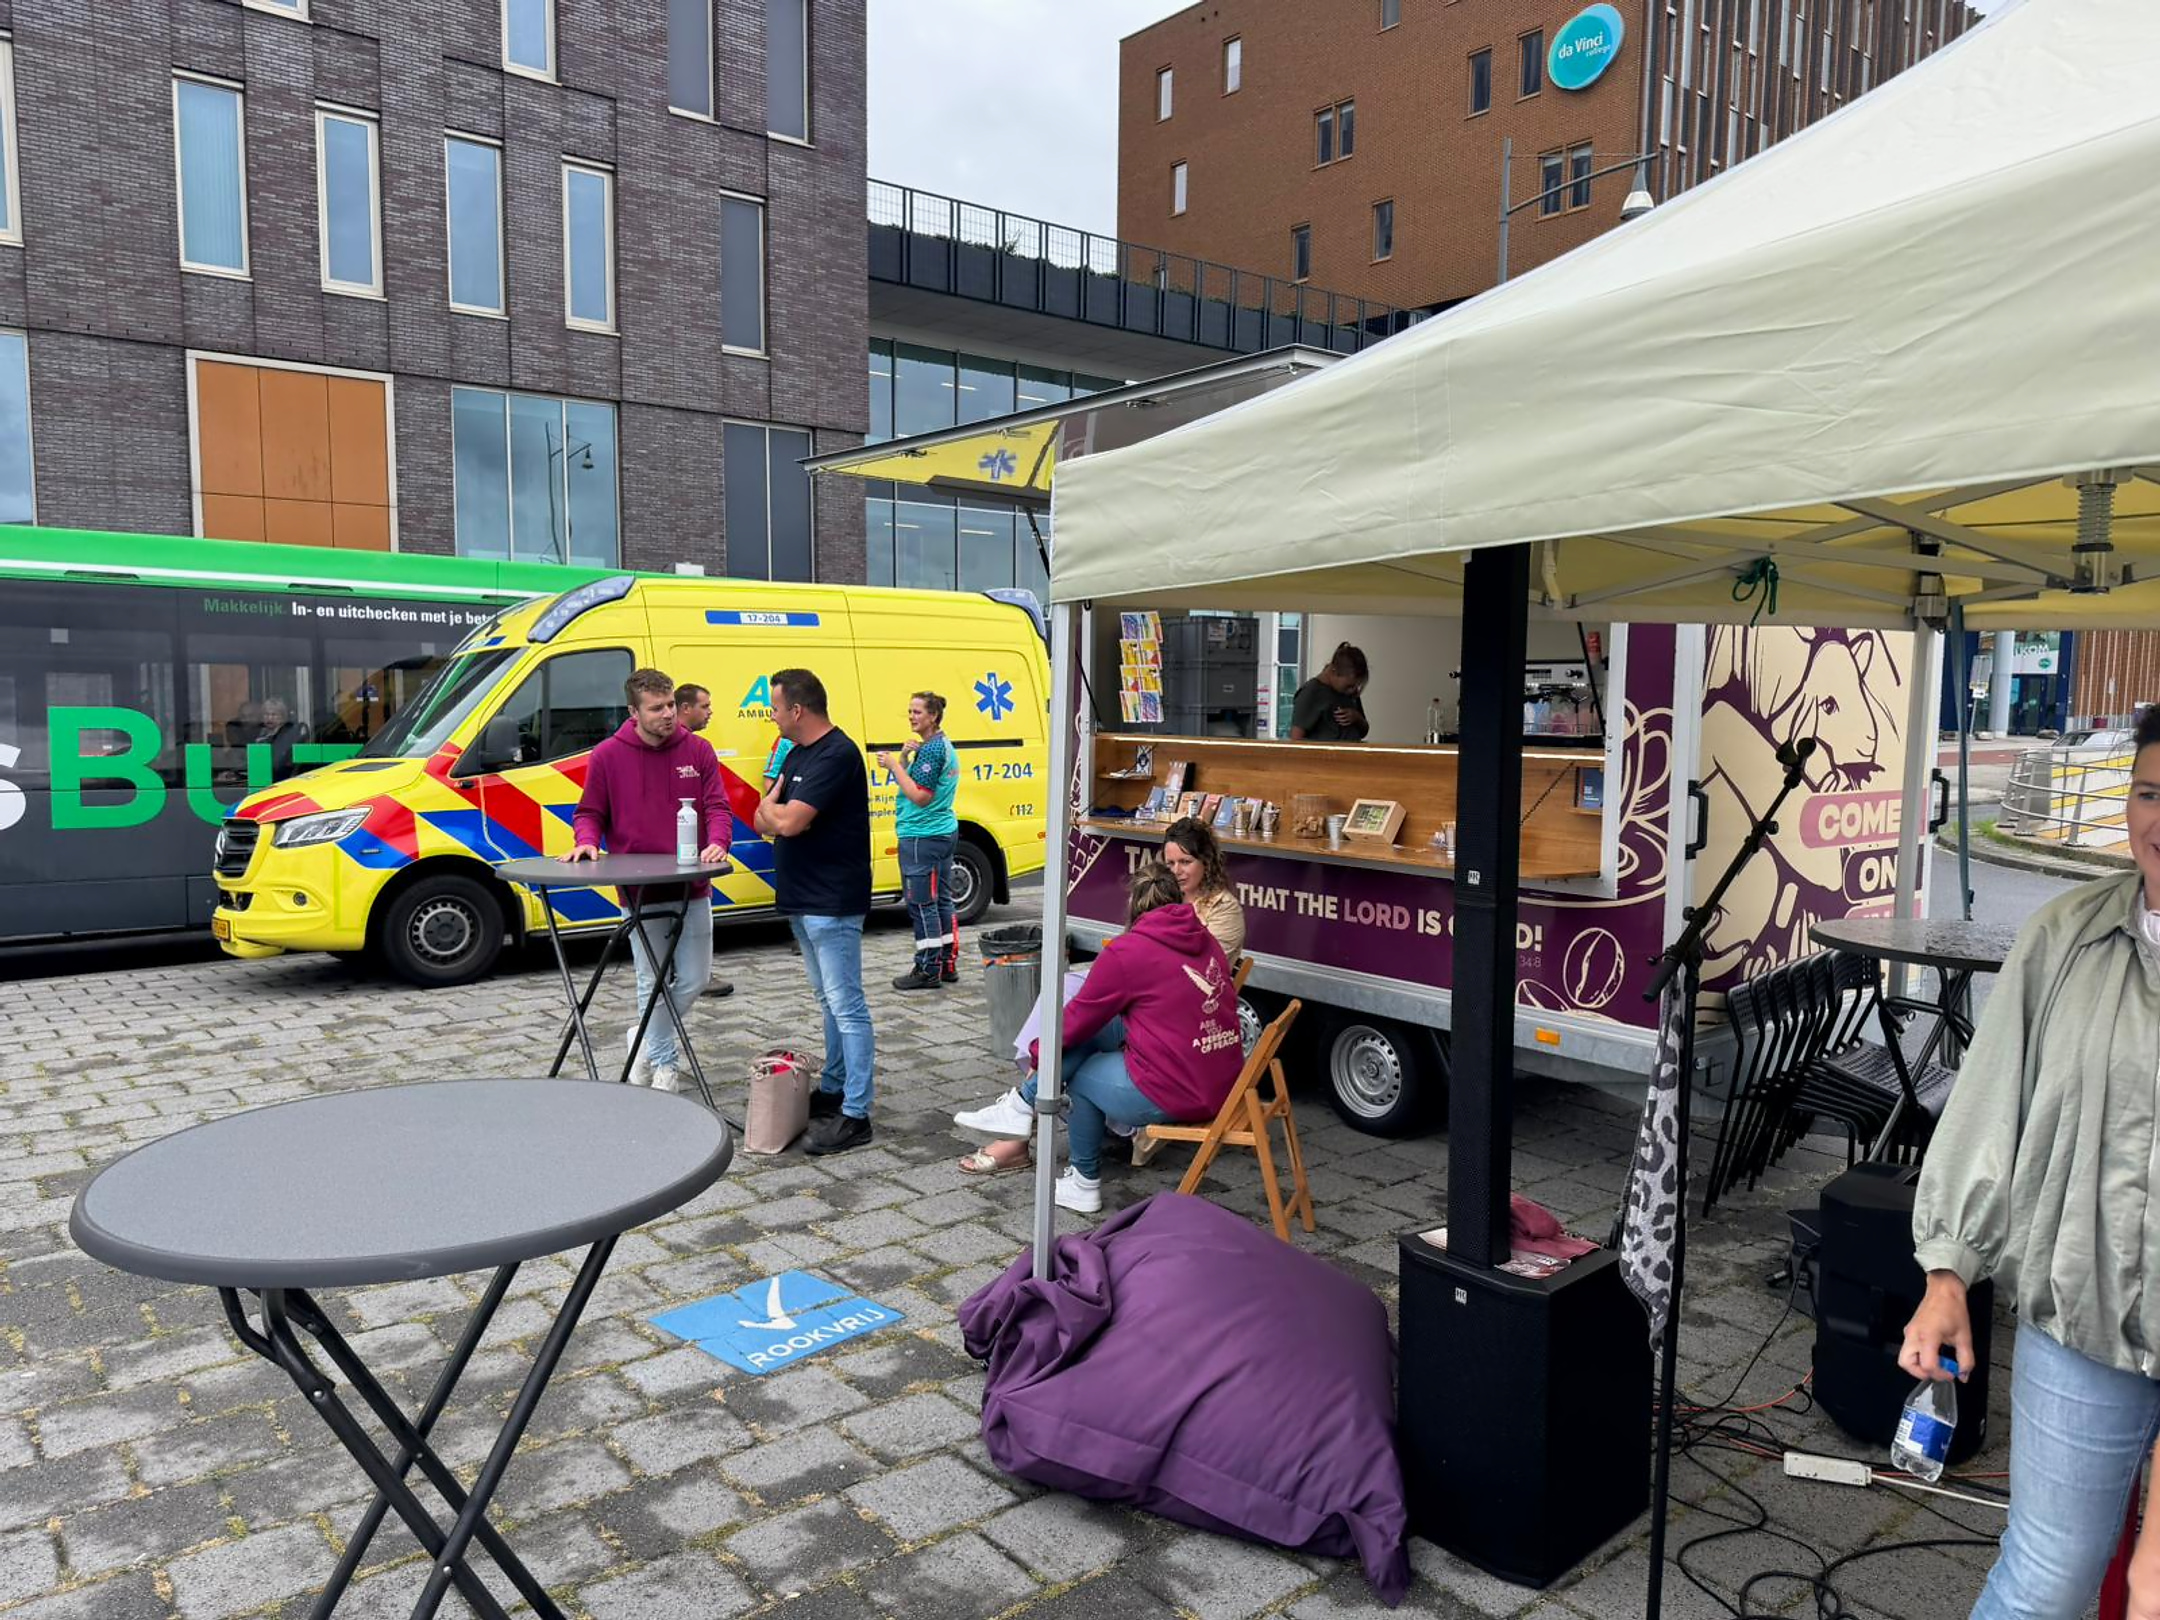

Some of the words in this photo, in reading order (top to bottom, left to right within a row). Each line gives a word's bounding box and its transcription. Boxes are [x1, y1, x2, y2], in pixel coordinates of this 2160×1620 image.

[1558, 44, 1573, 59] da
[1575, 31, 1604, 53] Vinci
[291, 601, 312, 616] In-
[316, 606, 335, 617] en
[338, 603, 418, 623] uitchecken
[420, 611, 447, 624] met
[449, 611, 463, 627] je
[746, 613, 782, 623] 17-204
[973, 762, 1034, 781] 17-204
[1015, 804, 1033, 816] 112
[1818, 799, 1902, 841] COME
[1236, 882, 1290, 912] THAT
[1294, 891, 1338, 920] THE
[1344, 898, 1411, 930] LORD
[1417, 908, 1442, 936] IS
[747, 1307, 886, 1368] ROOKVRIJ
